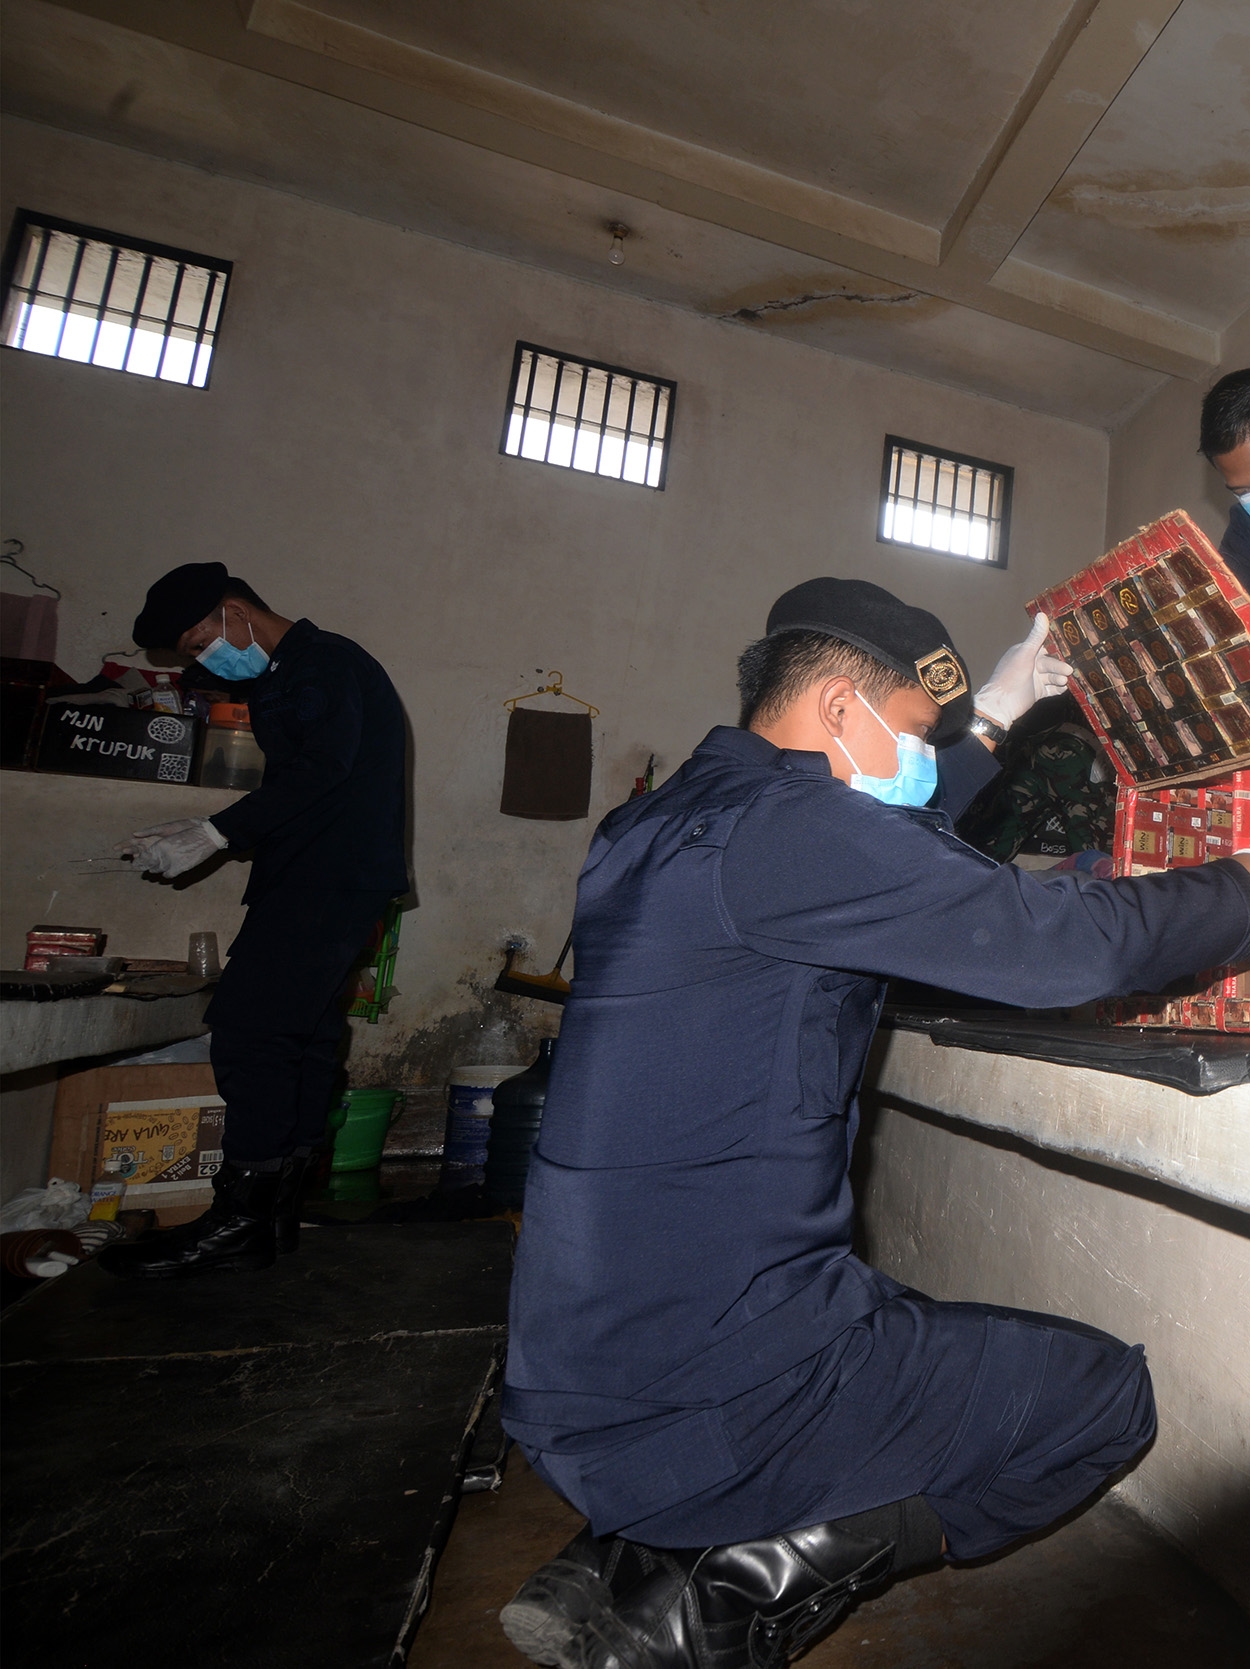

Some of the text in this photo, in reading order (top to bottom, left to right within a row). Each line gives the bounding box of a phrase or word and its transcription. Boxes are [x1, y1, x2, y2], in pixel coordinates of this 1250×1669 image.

[60, 709, 104, 732] MJN
[134, 1122, 171, 1141] GULA
[166, 1155, 191, 1174] EXTRA
[176, 1164, 192, 1177] Beli
[171, 1173, 179, 1181] 2
